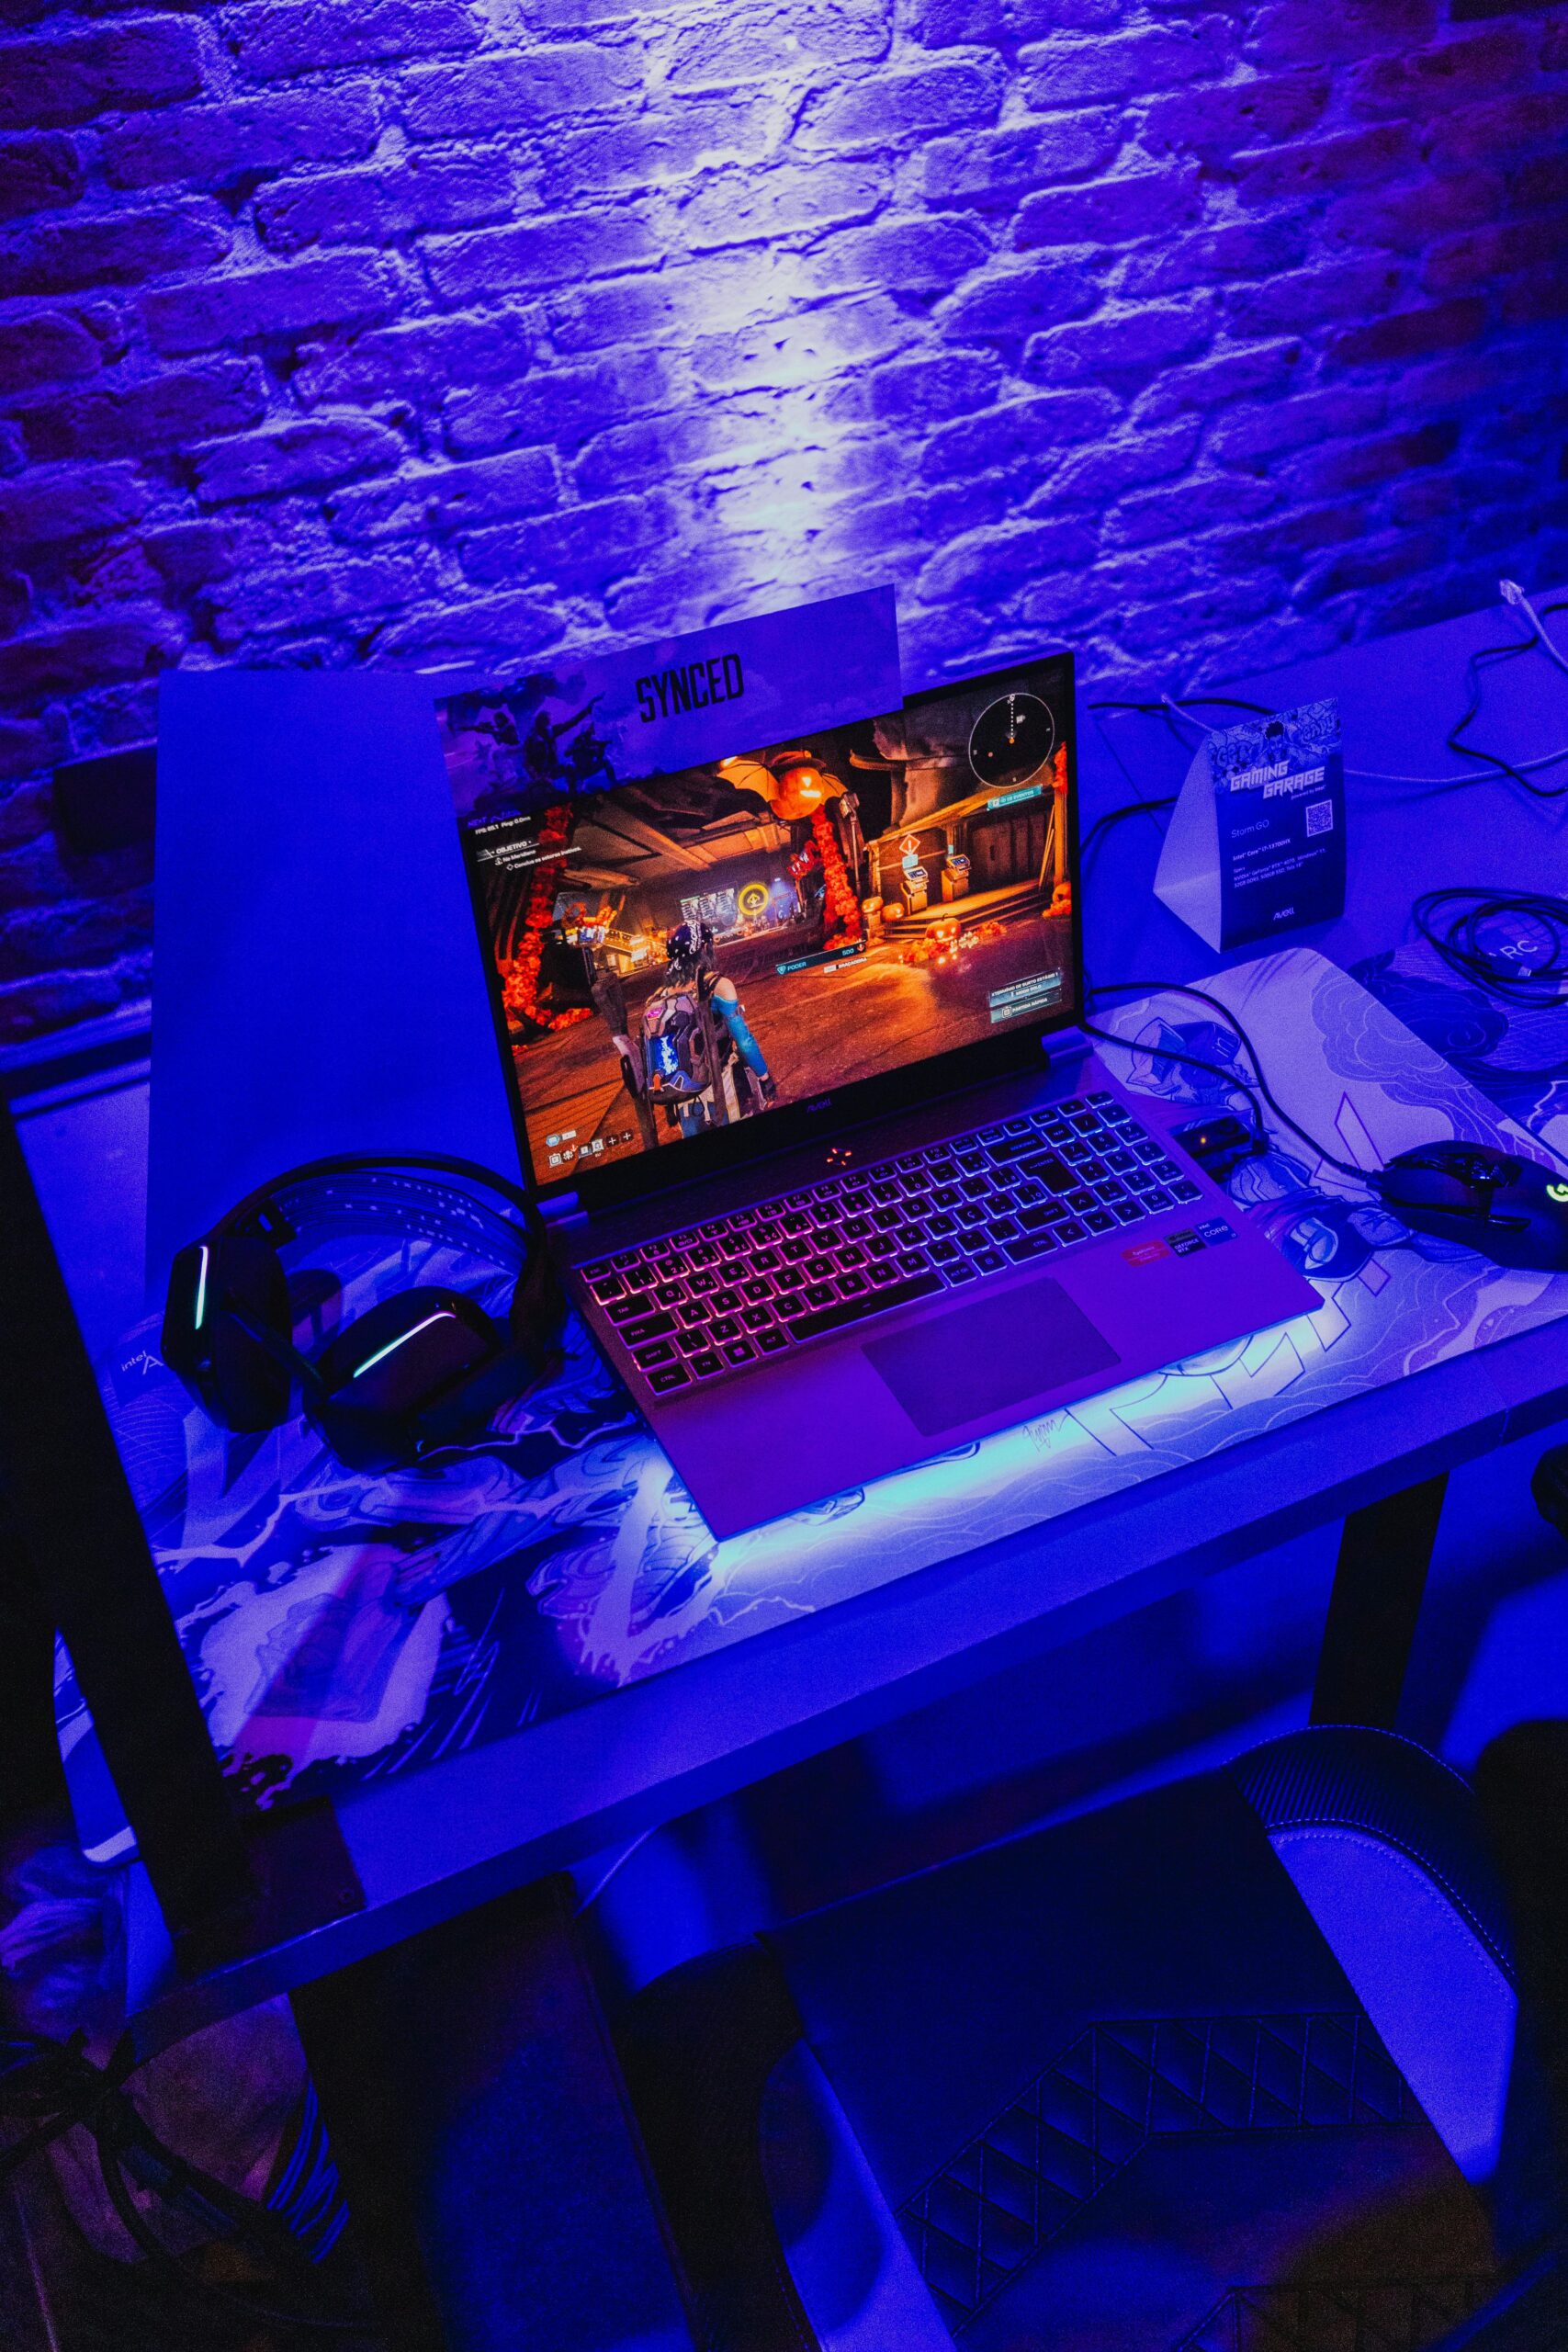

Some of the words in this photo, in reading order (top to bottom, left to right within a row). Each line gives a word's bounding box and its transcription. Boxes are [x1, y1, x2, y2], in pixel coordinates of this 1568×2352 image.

[636, 653, 744, 723] SYNCED
[1230, 760, 1291, 792] GAMING
[1263, 766, 1325, 799] GARAGE
[1231, 825, 1255, 838] Storm
[1256, 820, 1269, 831] GO
[496, 841, 527, 854] OBJETIVO
[787, 961, 807, 971] PODER
[907, 1231, 916, 1239] K
[908, 1258, 917, 1266] M
[696, 1278, 706, 1286] W
[784, 1274, 792, 1283] F
[847, 1280, 855, 1288] B
[720, 1325, 729, 1333] Z
[121, 1351, 148, 1372] intel
